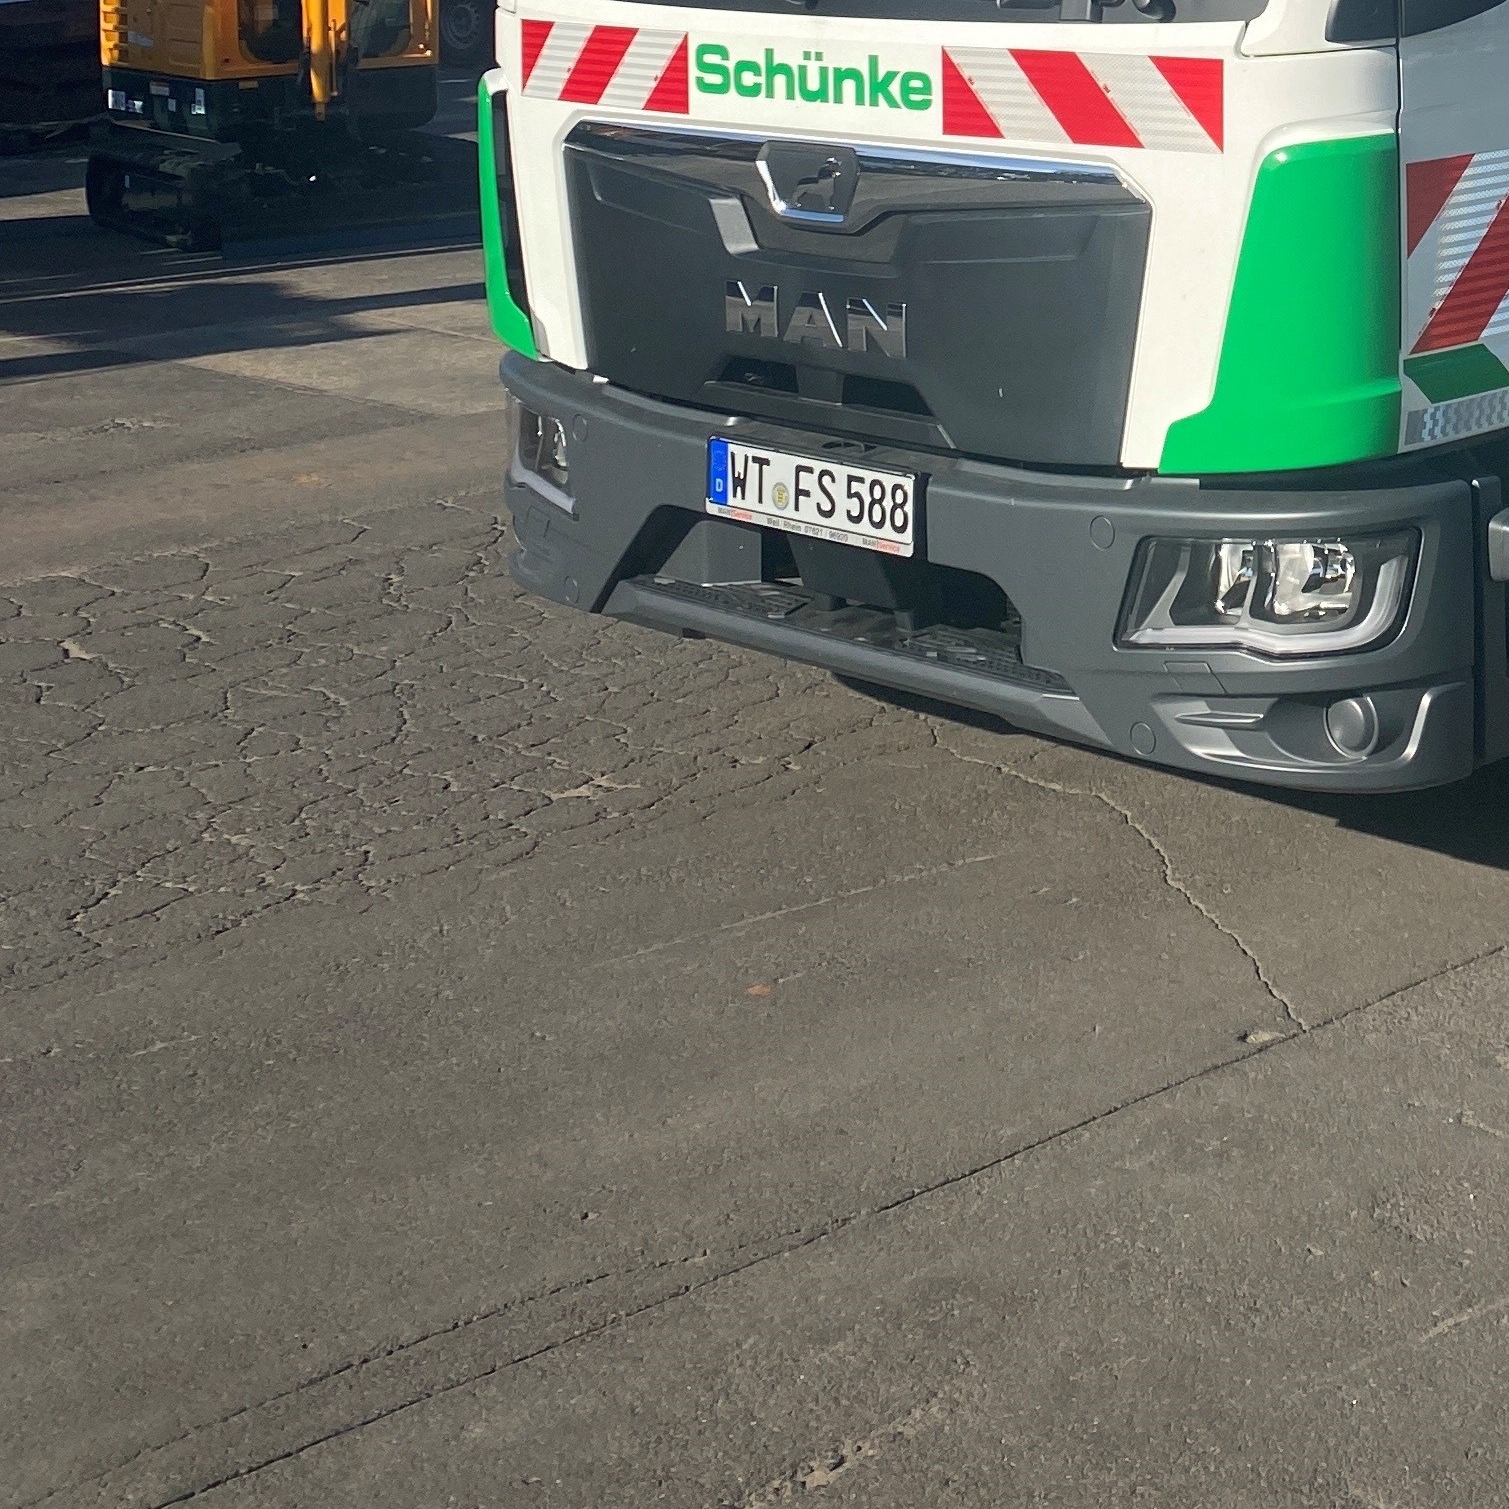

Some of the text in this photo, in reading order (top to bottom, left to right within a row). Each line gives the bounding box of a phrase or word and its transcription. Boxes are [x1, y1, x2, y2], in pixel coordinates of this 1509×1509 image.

[695, 43, 933, 111] Schünke
[725, 280, 907, 359] MAN
[715, 478, 723, 493] D
[730, 451, 909, 534] WT FS 588
